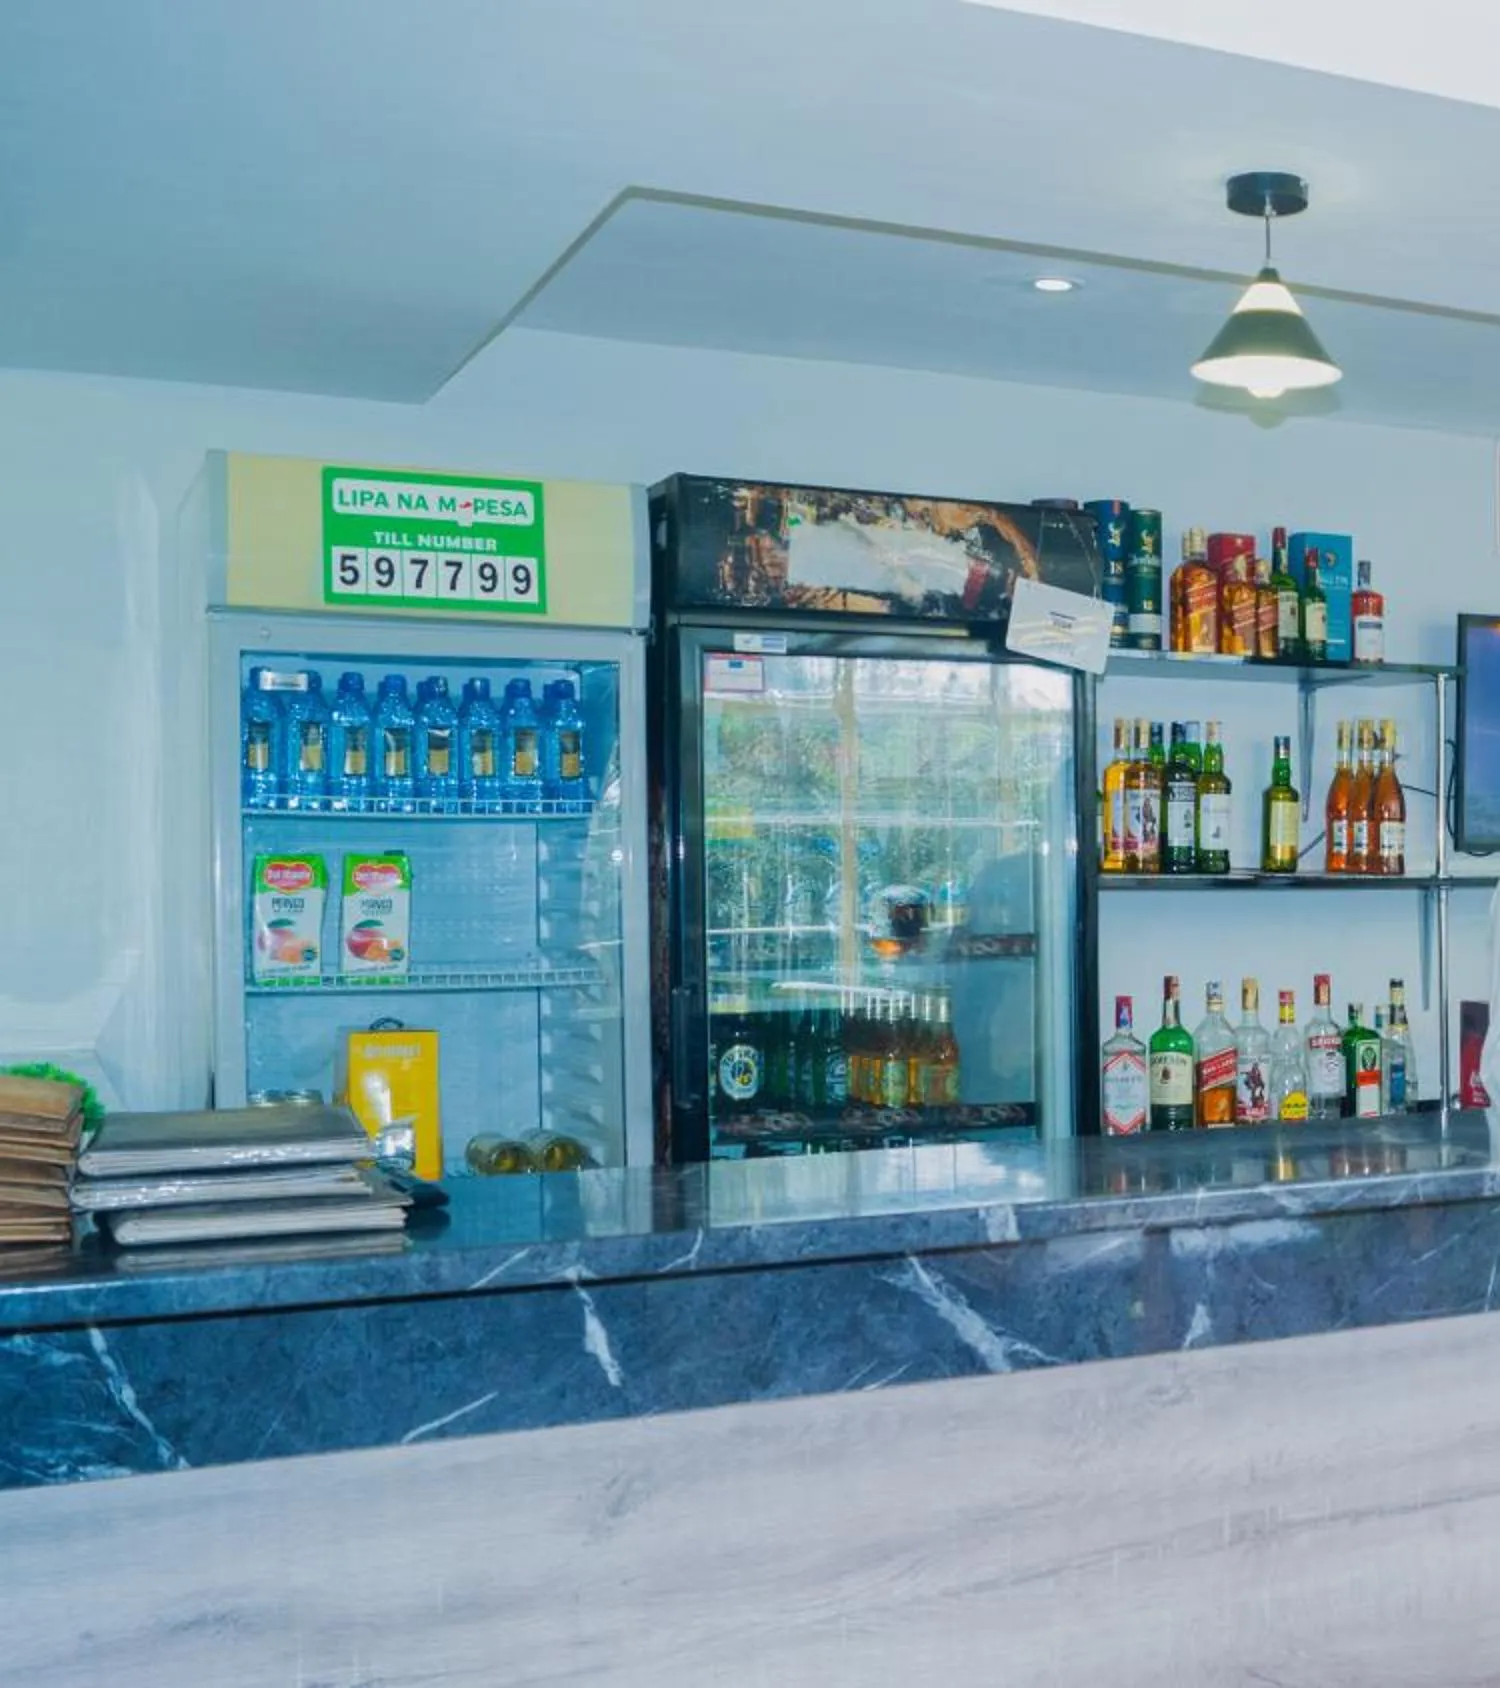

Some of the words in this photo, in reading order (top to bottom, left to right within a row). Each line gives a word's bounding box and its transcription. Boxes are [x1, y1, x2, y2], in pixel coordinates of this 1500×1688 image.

[338, 488, 390, 510] LIPA
[398, 492, 430, 511] NA
[373, 530, 413, 547] TILL
[417, 534, 498, 552] NUMBER
[338, 553, 532, 595] 597799
